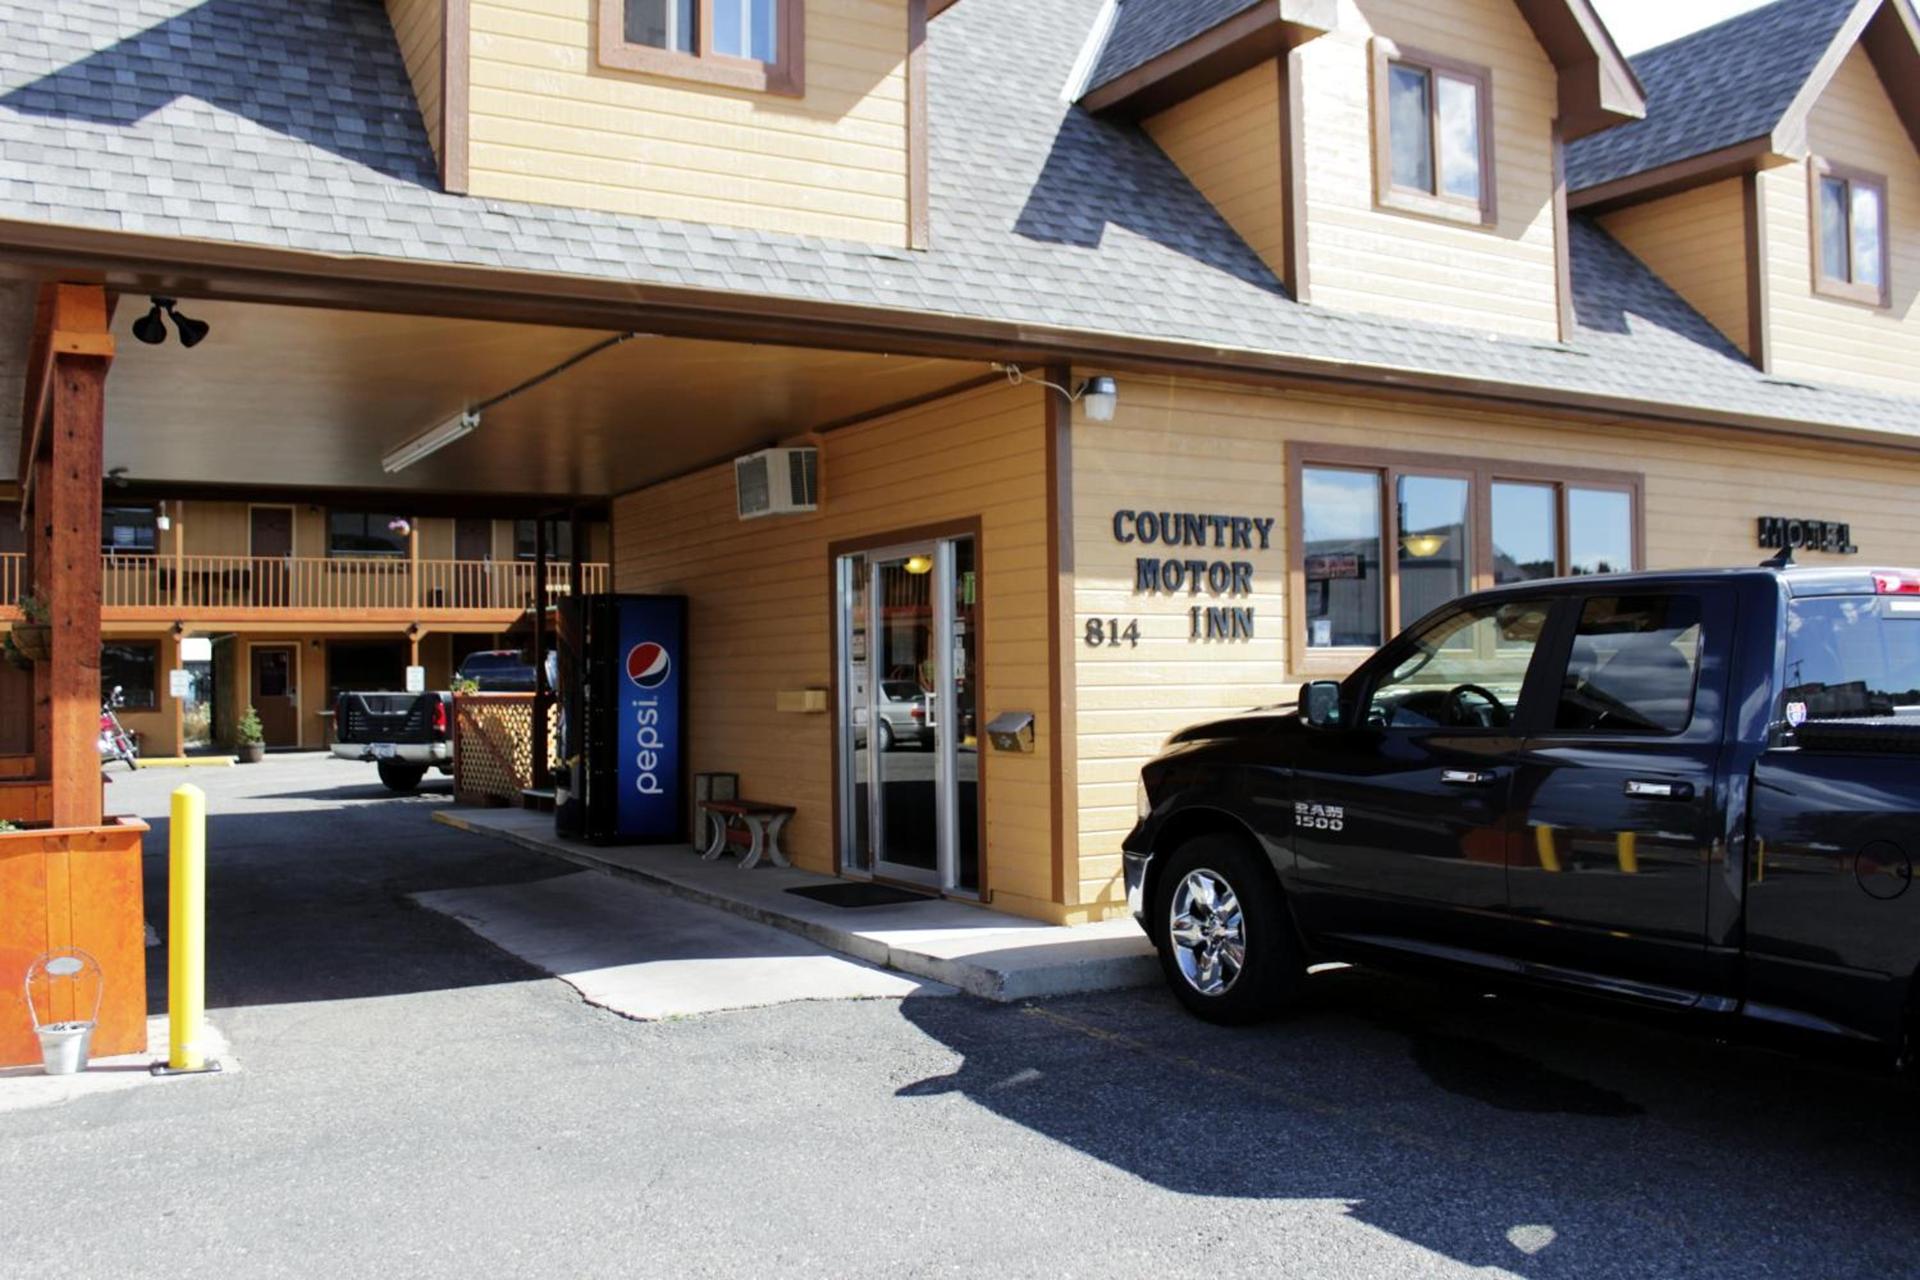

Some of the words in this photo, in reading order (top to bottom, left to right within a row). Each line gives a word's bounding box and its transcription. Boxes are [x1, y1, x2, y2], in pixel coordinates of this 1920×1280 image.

[1113, 509, 1274, 549] COUNTRY
[1136, 557, 1253, 594] MOTOR
[1085, 617, 1141, 648] 814
[1191, 606, 1254, 639] INN
[632, 698, 664, 794] pepsi
[1295, 802, 1343, 818] RAM
[1295, 815, 1343, 831] 1500
